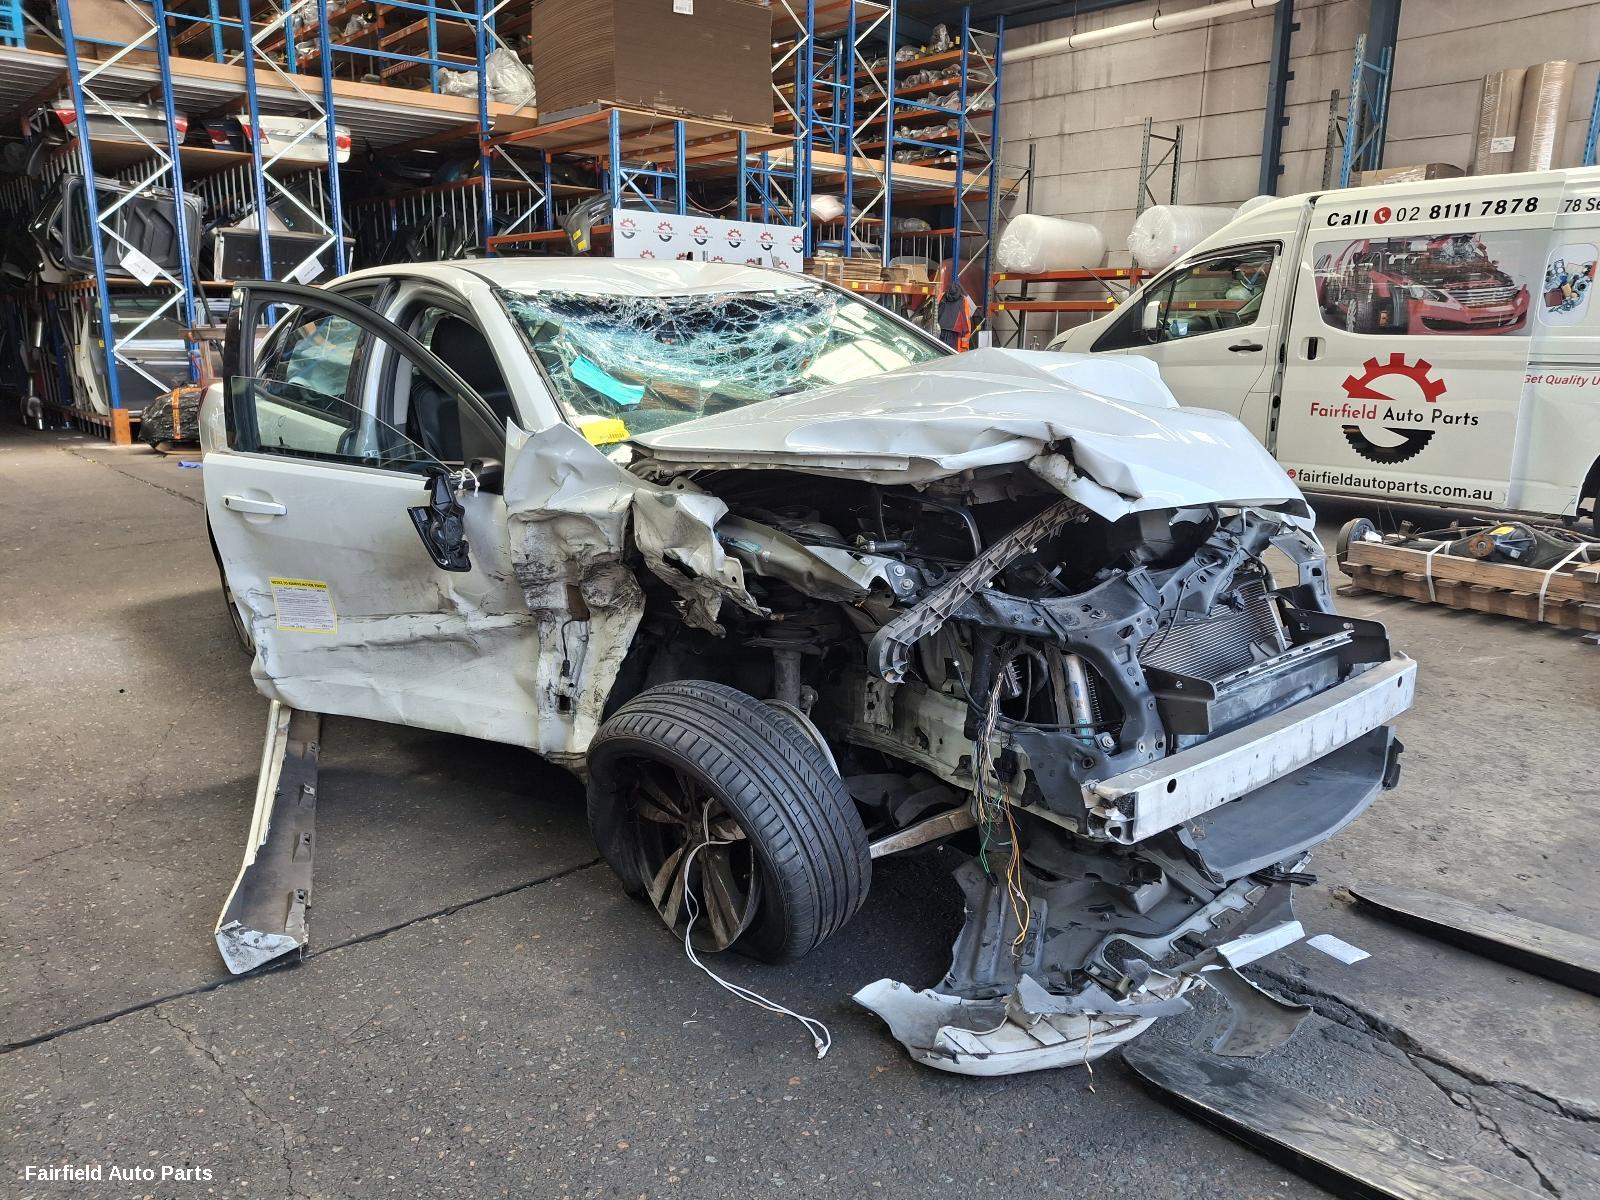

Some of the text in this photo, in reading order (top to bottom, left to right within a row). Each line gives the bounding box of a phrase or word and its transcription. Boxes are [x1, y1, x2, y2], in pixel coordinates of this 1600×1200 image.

[1326, 197, 1539, 227] Call 02 8111 7878
[1564, 199, 1582, 212] 78
[1545, 374, 1590, 388] Quality
[1310, 402, 1479, 426] Fairfield Auto Parts
[1298, 468, 1494, 500] fairfieldautoparts.com.au
